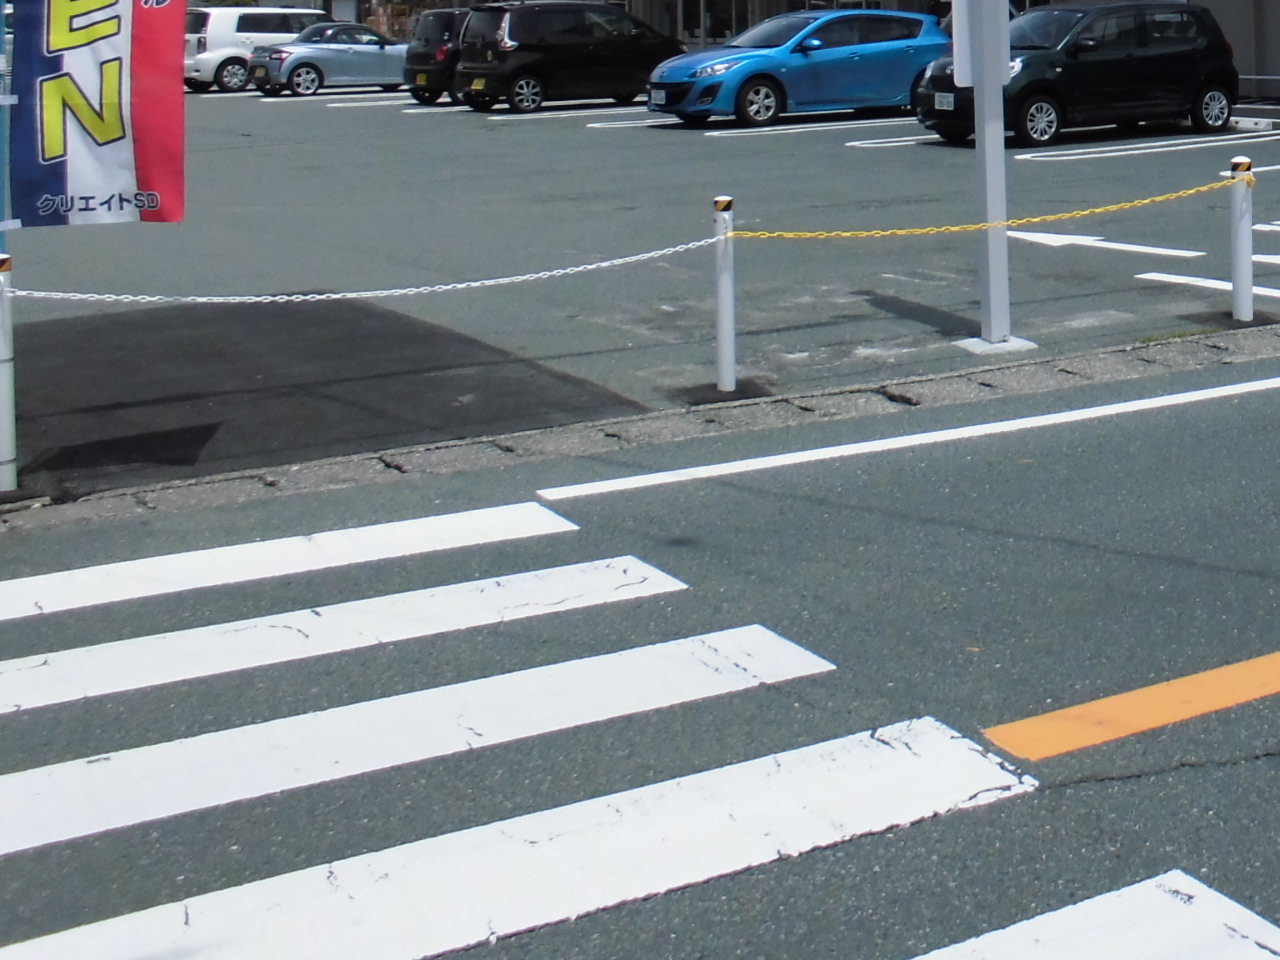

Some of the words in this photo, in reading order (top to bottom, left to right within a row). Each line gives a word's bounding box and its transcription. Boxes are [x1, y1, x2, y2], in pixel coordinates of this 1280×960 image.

[37, 192, 160, 215] クリエイトSD
